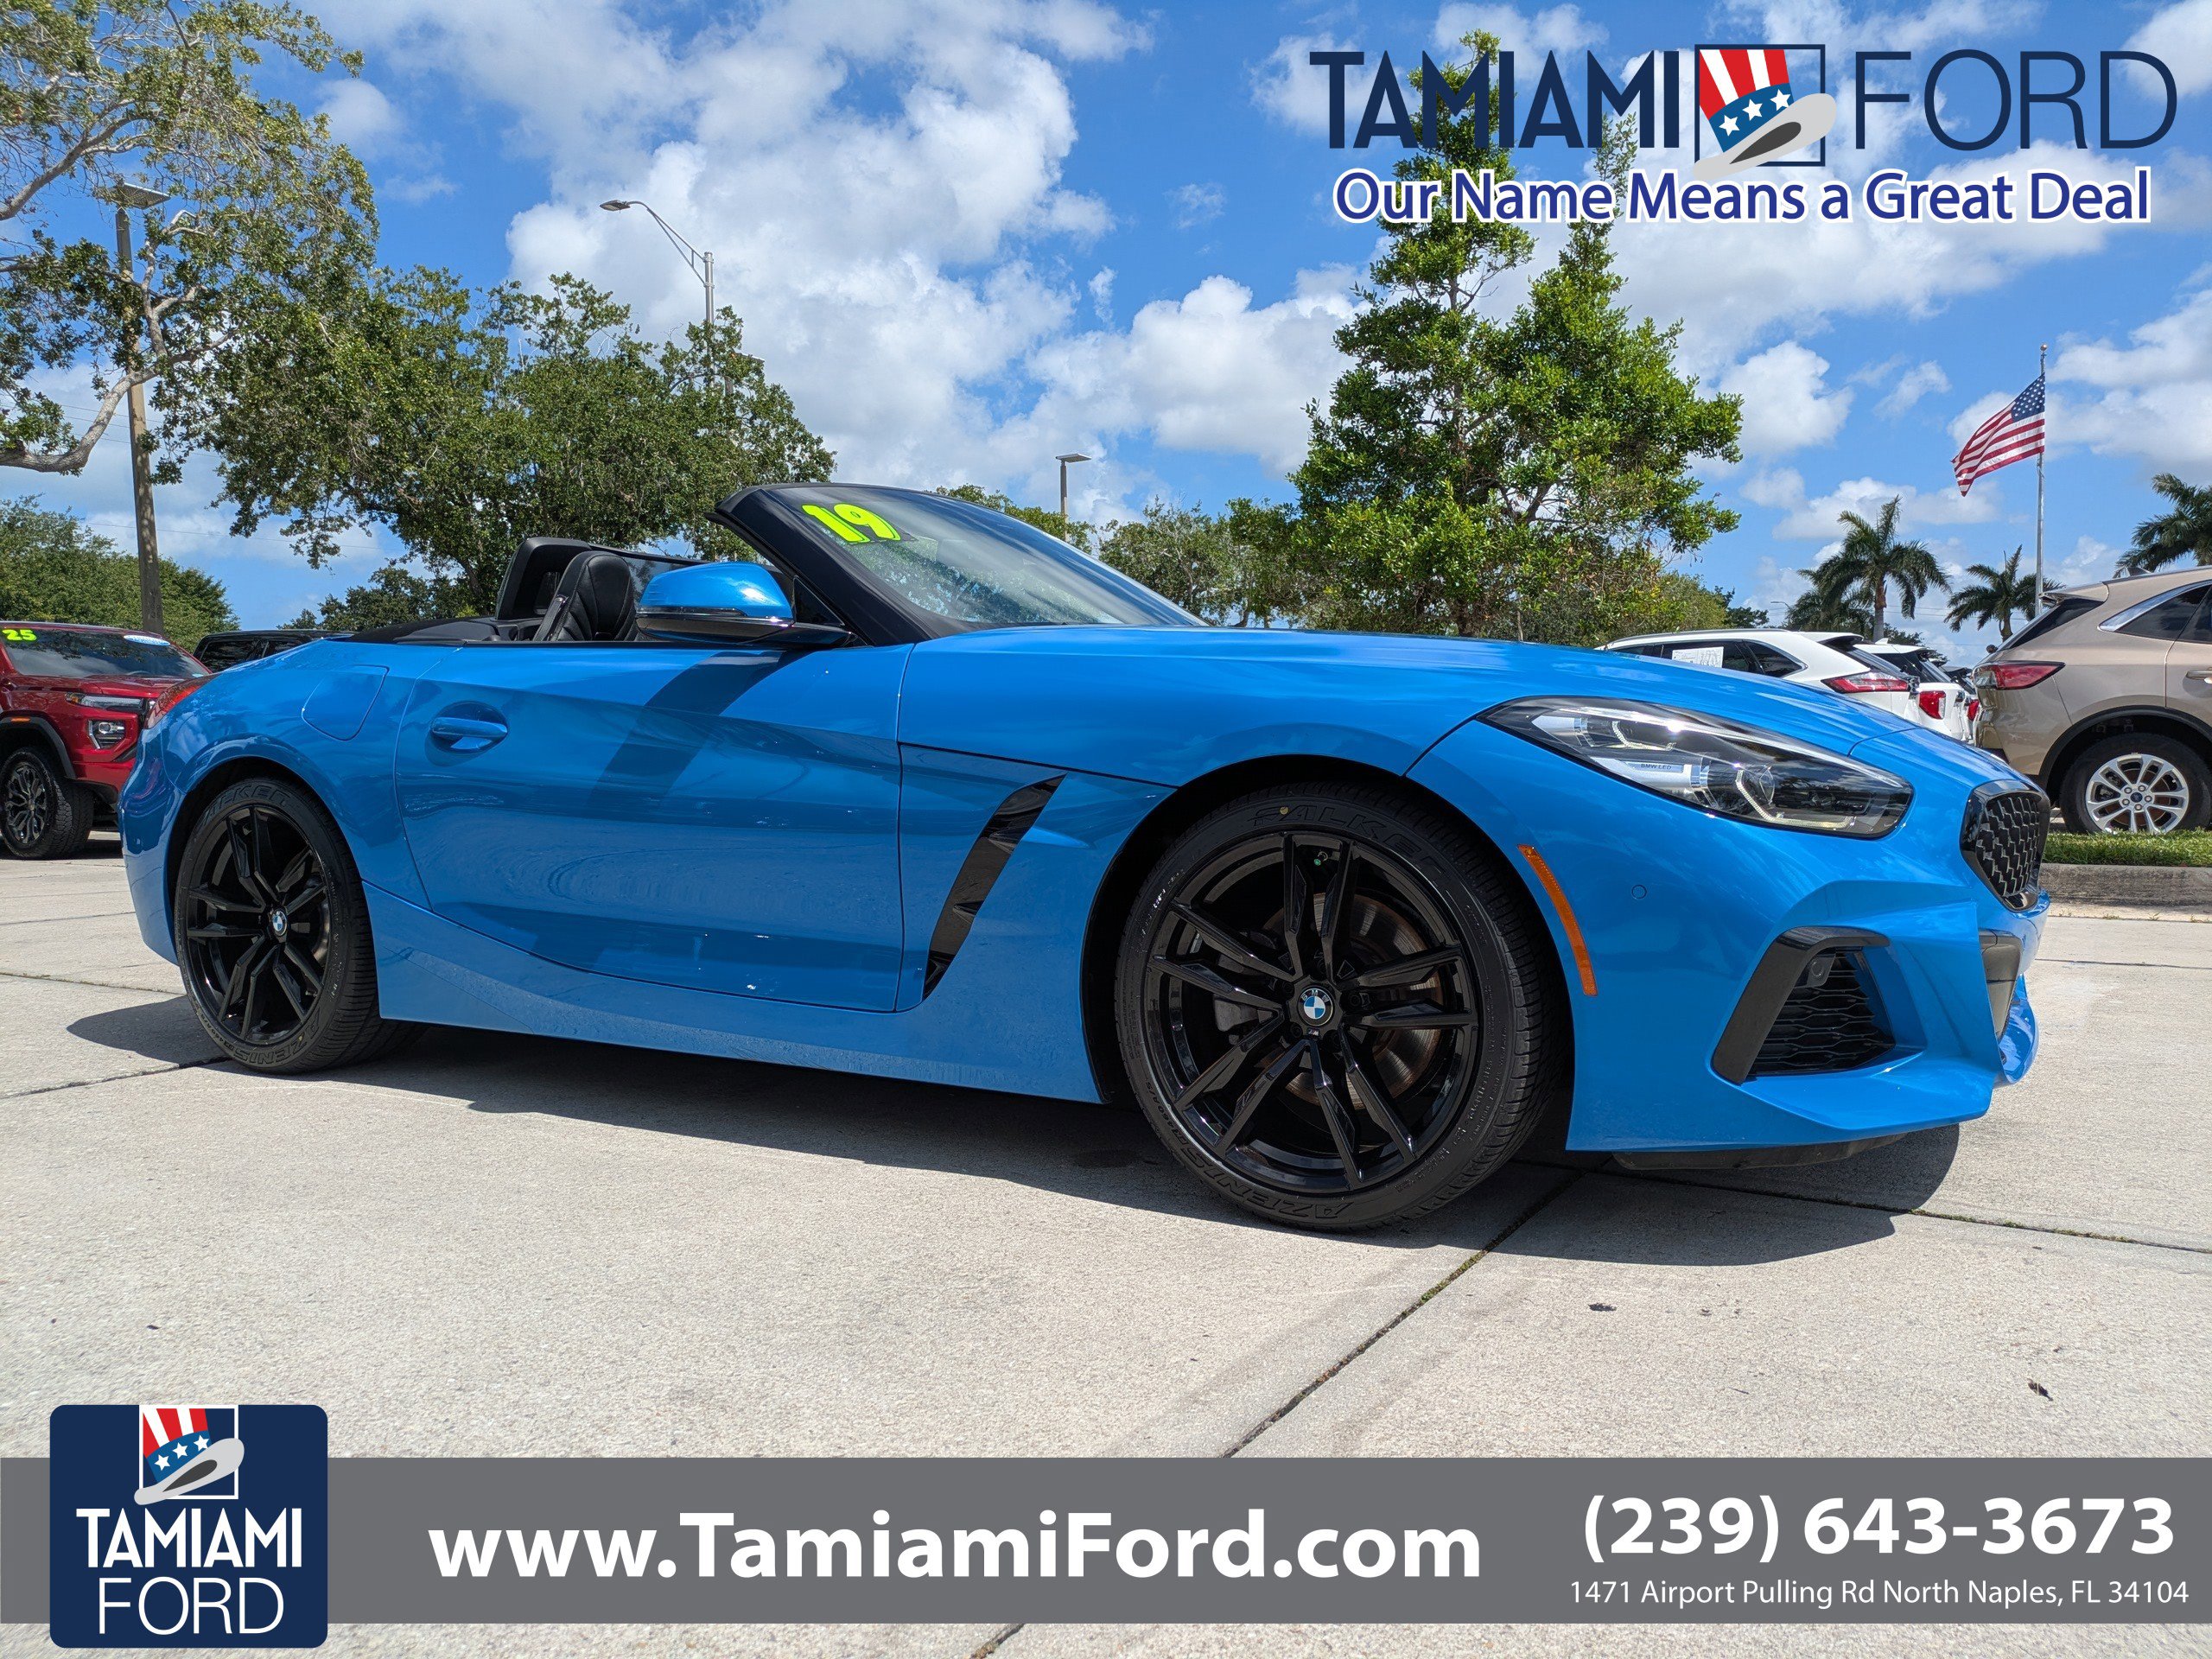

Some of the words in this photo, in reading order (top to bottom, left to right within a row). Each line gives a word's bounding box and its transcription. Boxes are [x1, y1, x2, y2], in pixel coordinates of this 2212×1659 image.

[802, 503, 901, 544] 19
[2, 629, 37, 641] 25
[1300, 989, 1330, 1003] BMW
[1180, 1146, 1355, 1219] AZENIS
